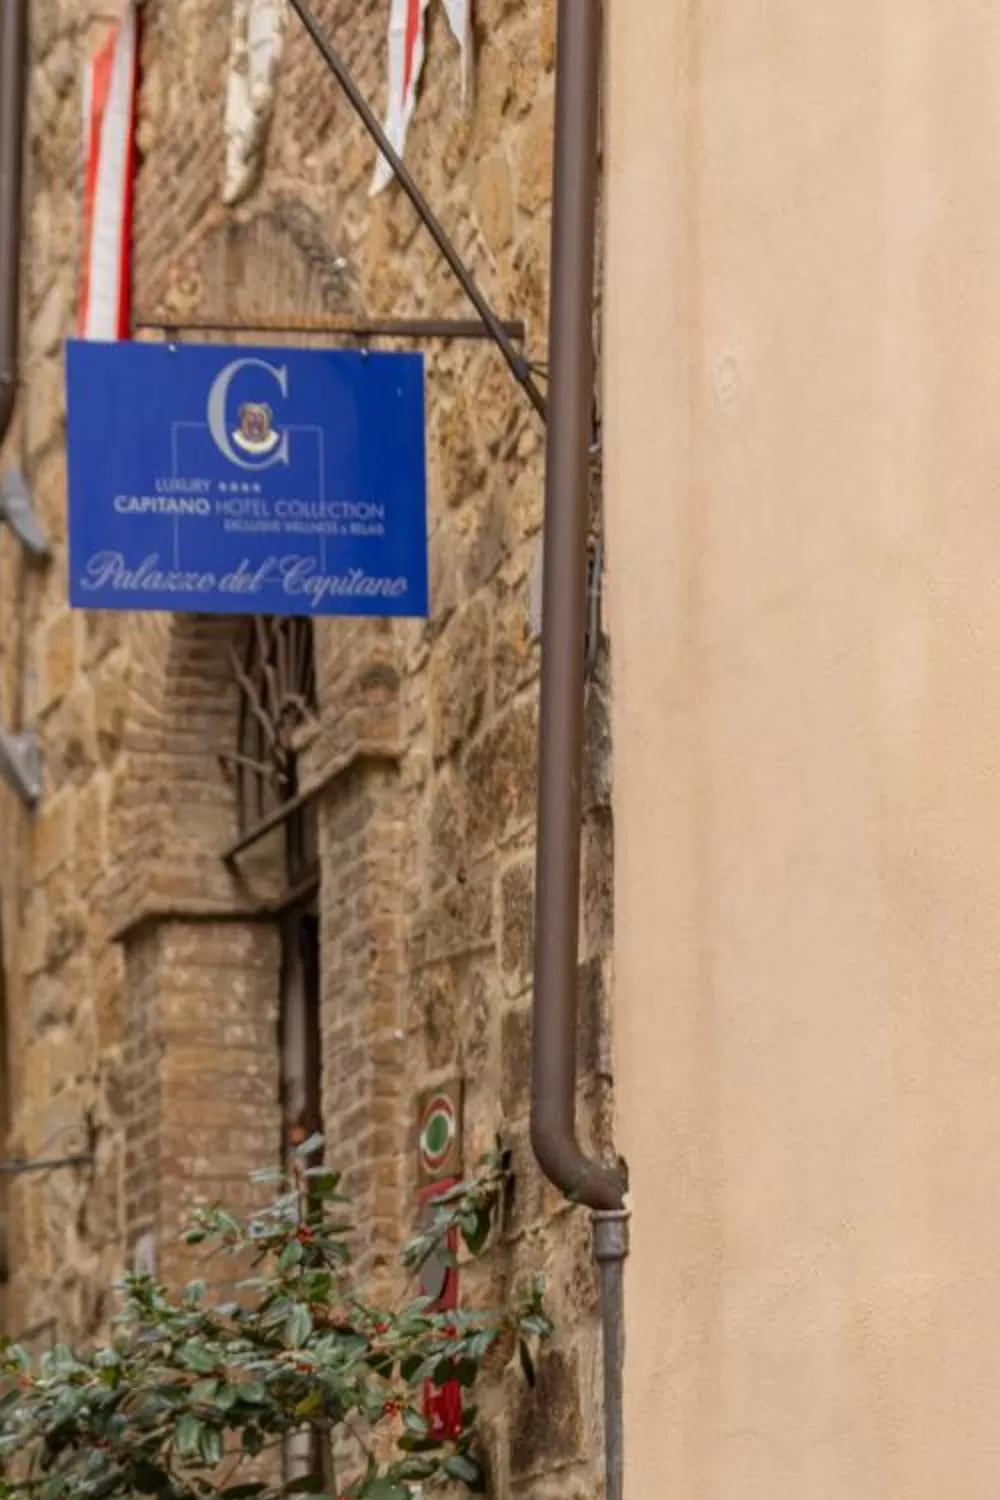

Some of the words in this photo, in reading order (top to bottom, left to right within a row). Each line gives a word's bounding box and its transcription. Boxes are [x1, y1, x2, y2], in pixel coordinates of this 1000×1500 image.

[155, 478, 211, 493] LUXURY
[113, 495, 211, 515] CAPITANO
[215, 498, 270, 517] HOTEL
[274, 500, 385, 520] COLLECTION
[80, 550, 216, 591] Palazzo
[218, 556, 277, 593] del
[280, 554, 408, 608] Capitano
